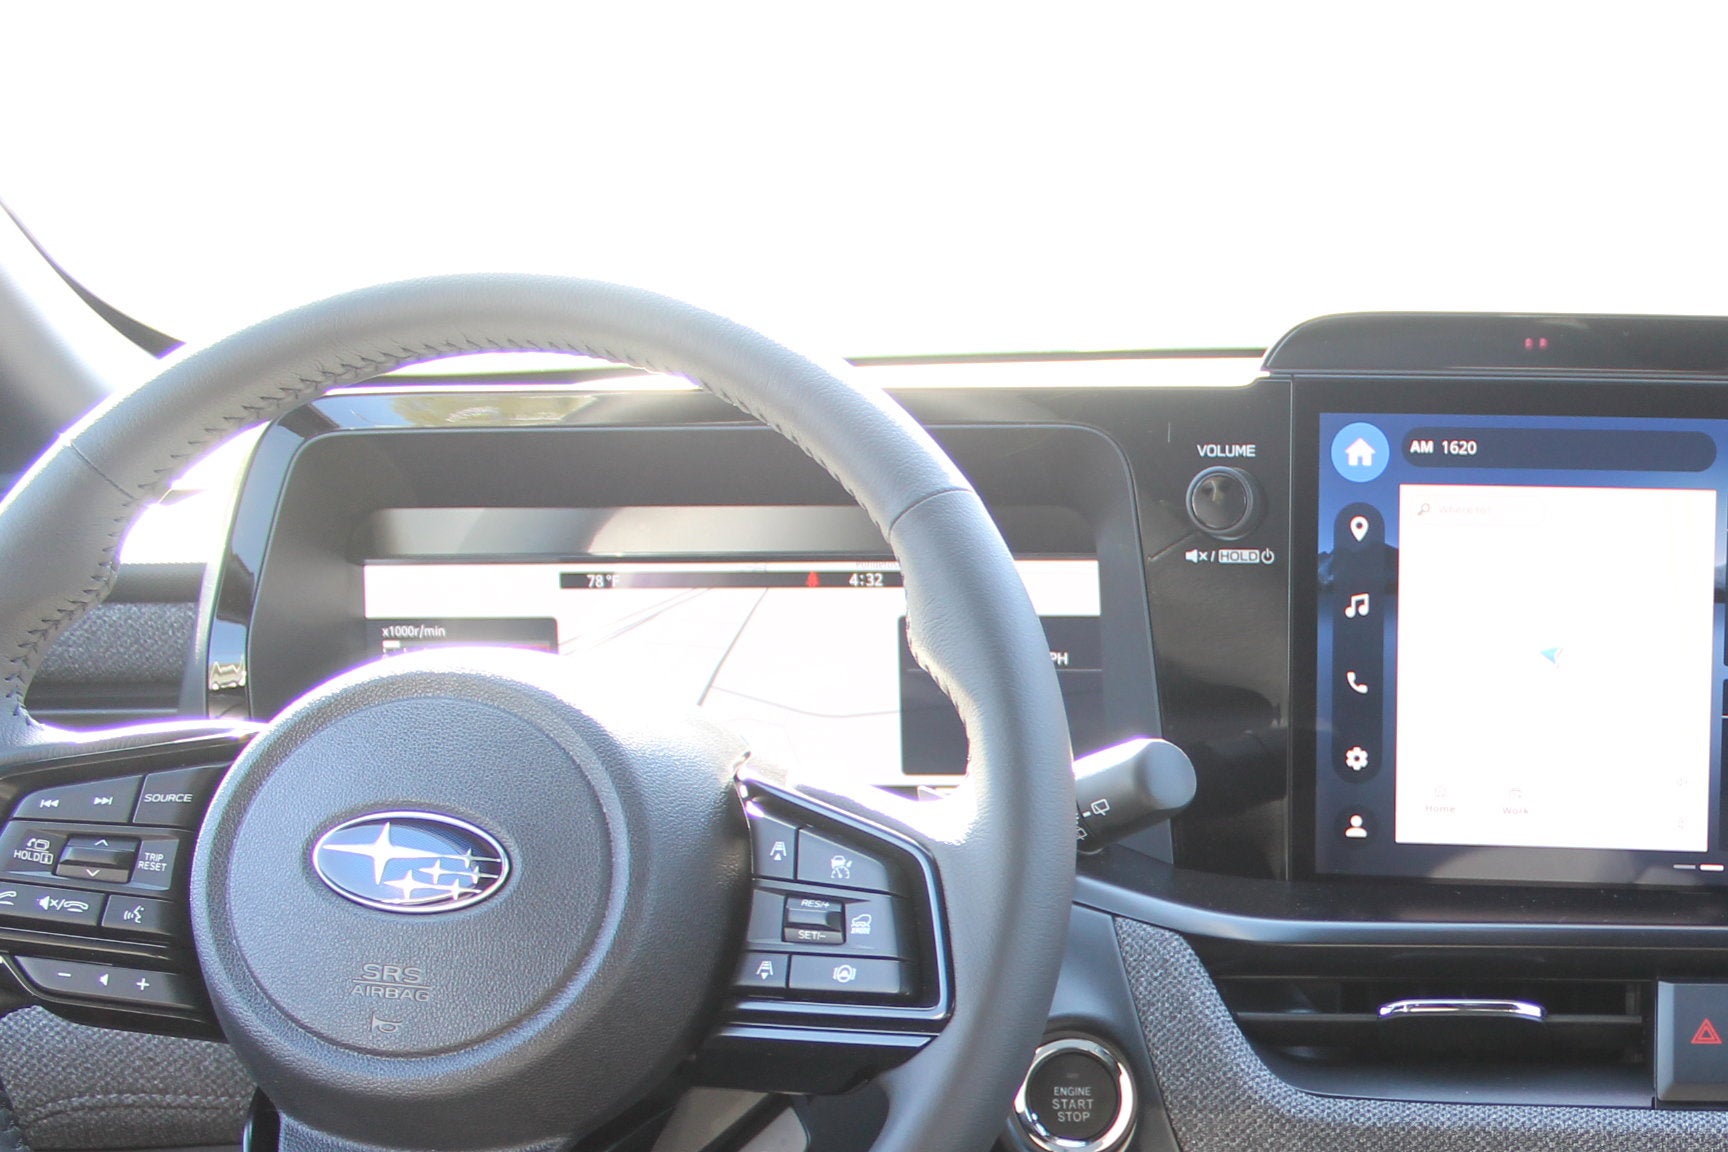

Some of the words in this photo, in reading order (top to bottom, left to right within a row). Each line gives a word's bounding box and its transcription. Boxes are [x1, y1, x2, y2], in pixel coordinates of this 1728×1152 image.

[1196, 444, 1256, 458] VOLUME
[1409, 440, 1434, 454] AM
[1441, 440, 1478, 456] 1620
[1219, 550, 1259, 562] HOLD
[849, 573, 884, 587] 4:32
[382, 624, 447, 639] x1000r/min
[1049, 651, 1069, 666] PH
[144, 793, 193, 804] SOURCE
[13, 849, 41, 863] HOLD
[145, 851, 164, 862] TRIP
[138, 860, 168, 872] RESET
[362, 963, 422, 984] SRS
[351, 984, 431, 1002] AIRBAG
[1053, 1086, 1092, 1097] ENGINE
[1052, 1098, 1094, 1110] START
[1057, 1111, 1091, 1123] STOP
